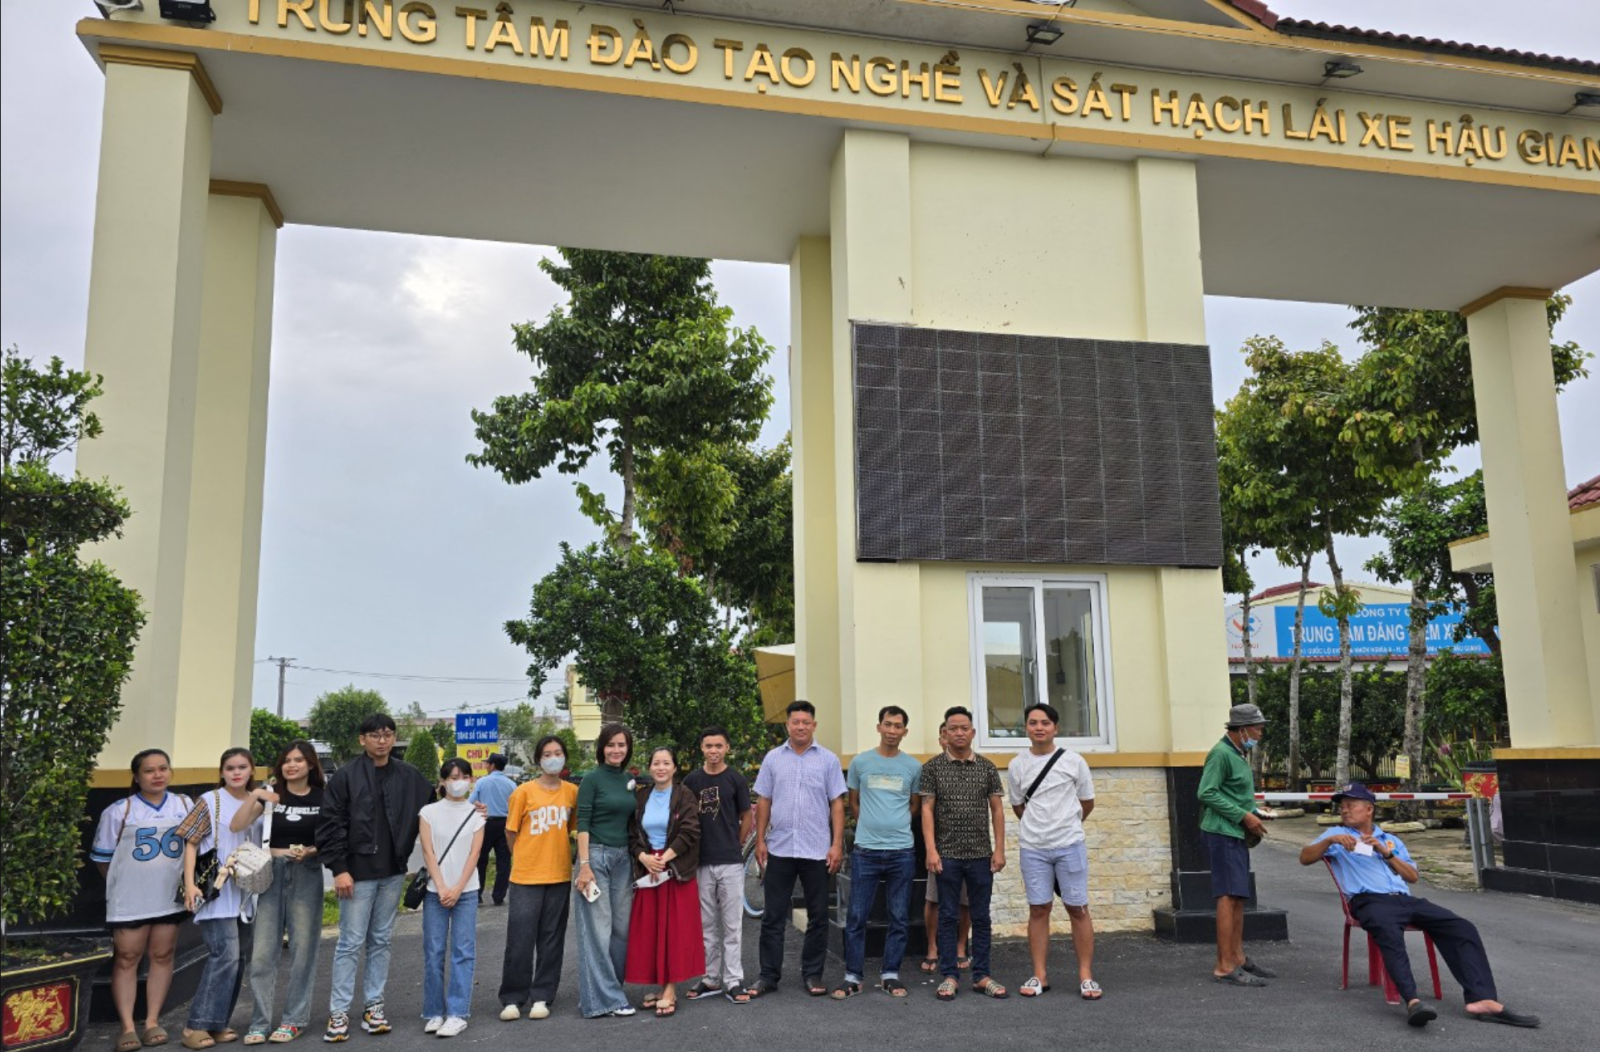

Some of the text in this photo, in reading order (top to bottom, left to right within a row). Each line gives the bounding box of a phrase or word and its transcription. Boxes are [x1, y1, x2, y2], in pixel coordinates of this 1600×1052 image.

[455, 2, 569, 60] TÂM
[586, 18, 699, 75] ĐÀO
[713, 38, 816, 94] TẠO
[830, 50, 963, 104] NGHỀ
[977, 62, 1040, 111] VÀ
[1051, 72, 1138, 121] SÁT
[1151, 88, 1271, 138] HẠCH
[1282, 98, 1348, 144] LÁI
[1358, 111, 1415, 151] XE
[1427, 114, 1508, 166] HẬU
[1388, 607, 1401, 617] TY
[1367, 621, 1405, 641] ĐĂNG
[132, 825, 184, 862] 56
